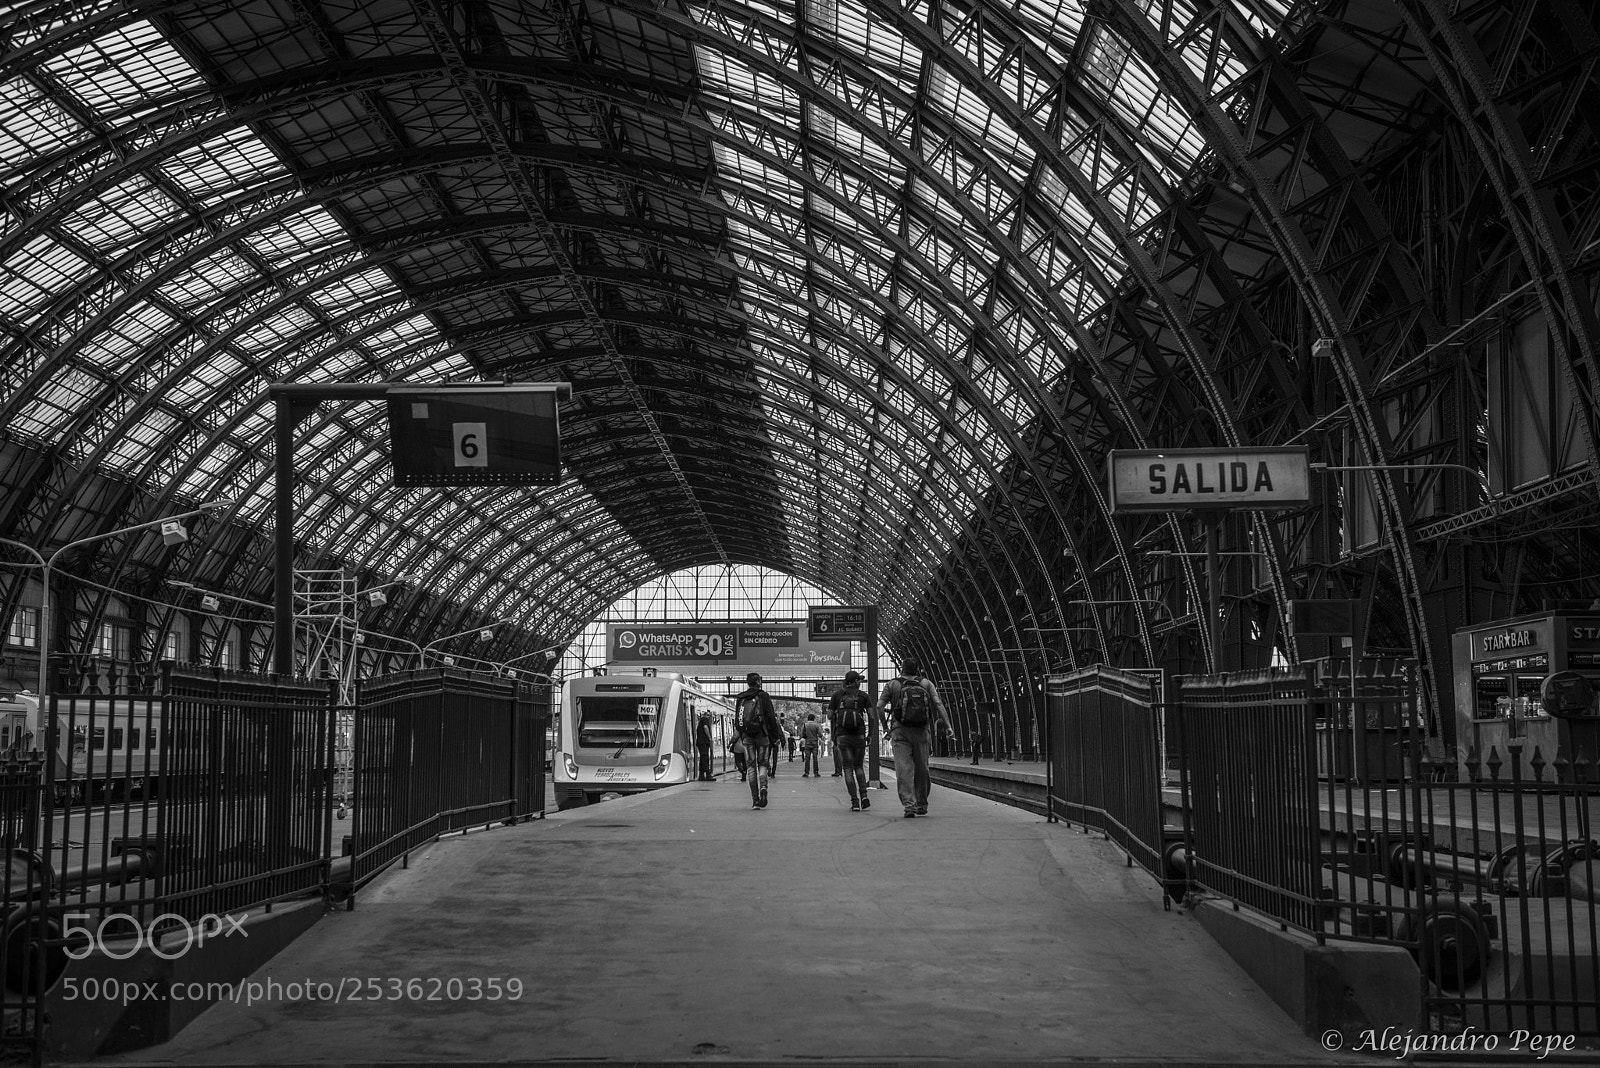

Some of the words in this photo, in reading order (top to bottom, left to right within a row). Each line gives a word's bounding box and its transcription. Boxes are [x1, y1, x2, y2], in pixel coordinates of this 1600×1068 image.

[460, 433, 479, 458] 6
[1148, 461, 1274, 495] SALIDA
[820, 620, 828, 632] 6
[638, 633, 693, 645] WhatsApp
[772, 630, 793, 638] quedes
[1483, 634, 1505, 651] STAR
[1510, 630, 1530, 647] BAR
[638, 645, 682, 657] GRATIS
[695, 634, 723, 656] 30
[723, 634, 734, 656] DÍAS
[809, 650, 845, 663] Personal
[640, 706, 654, 714] M02
